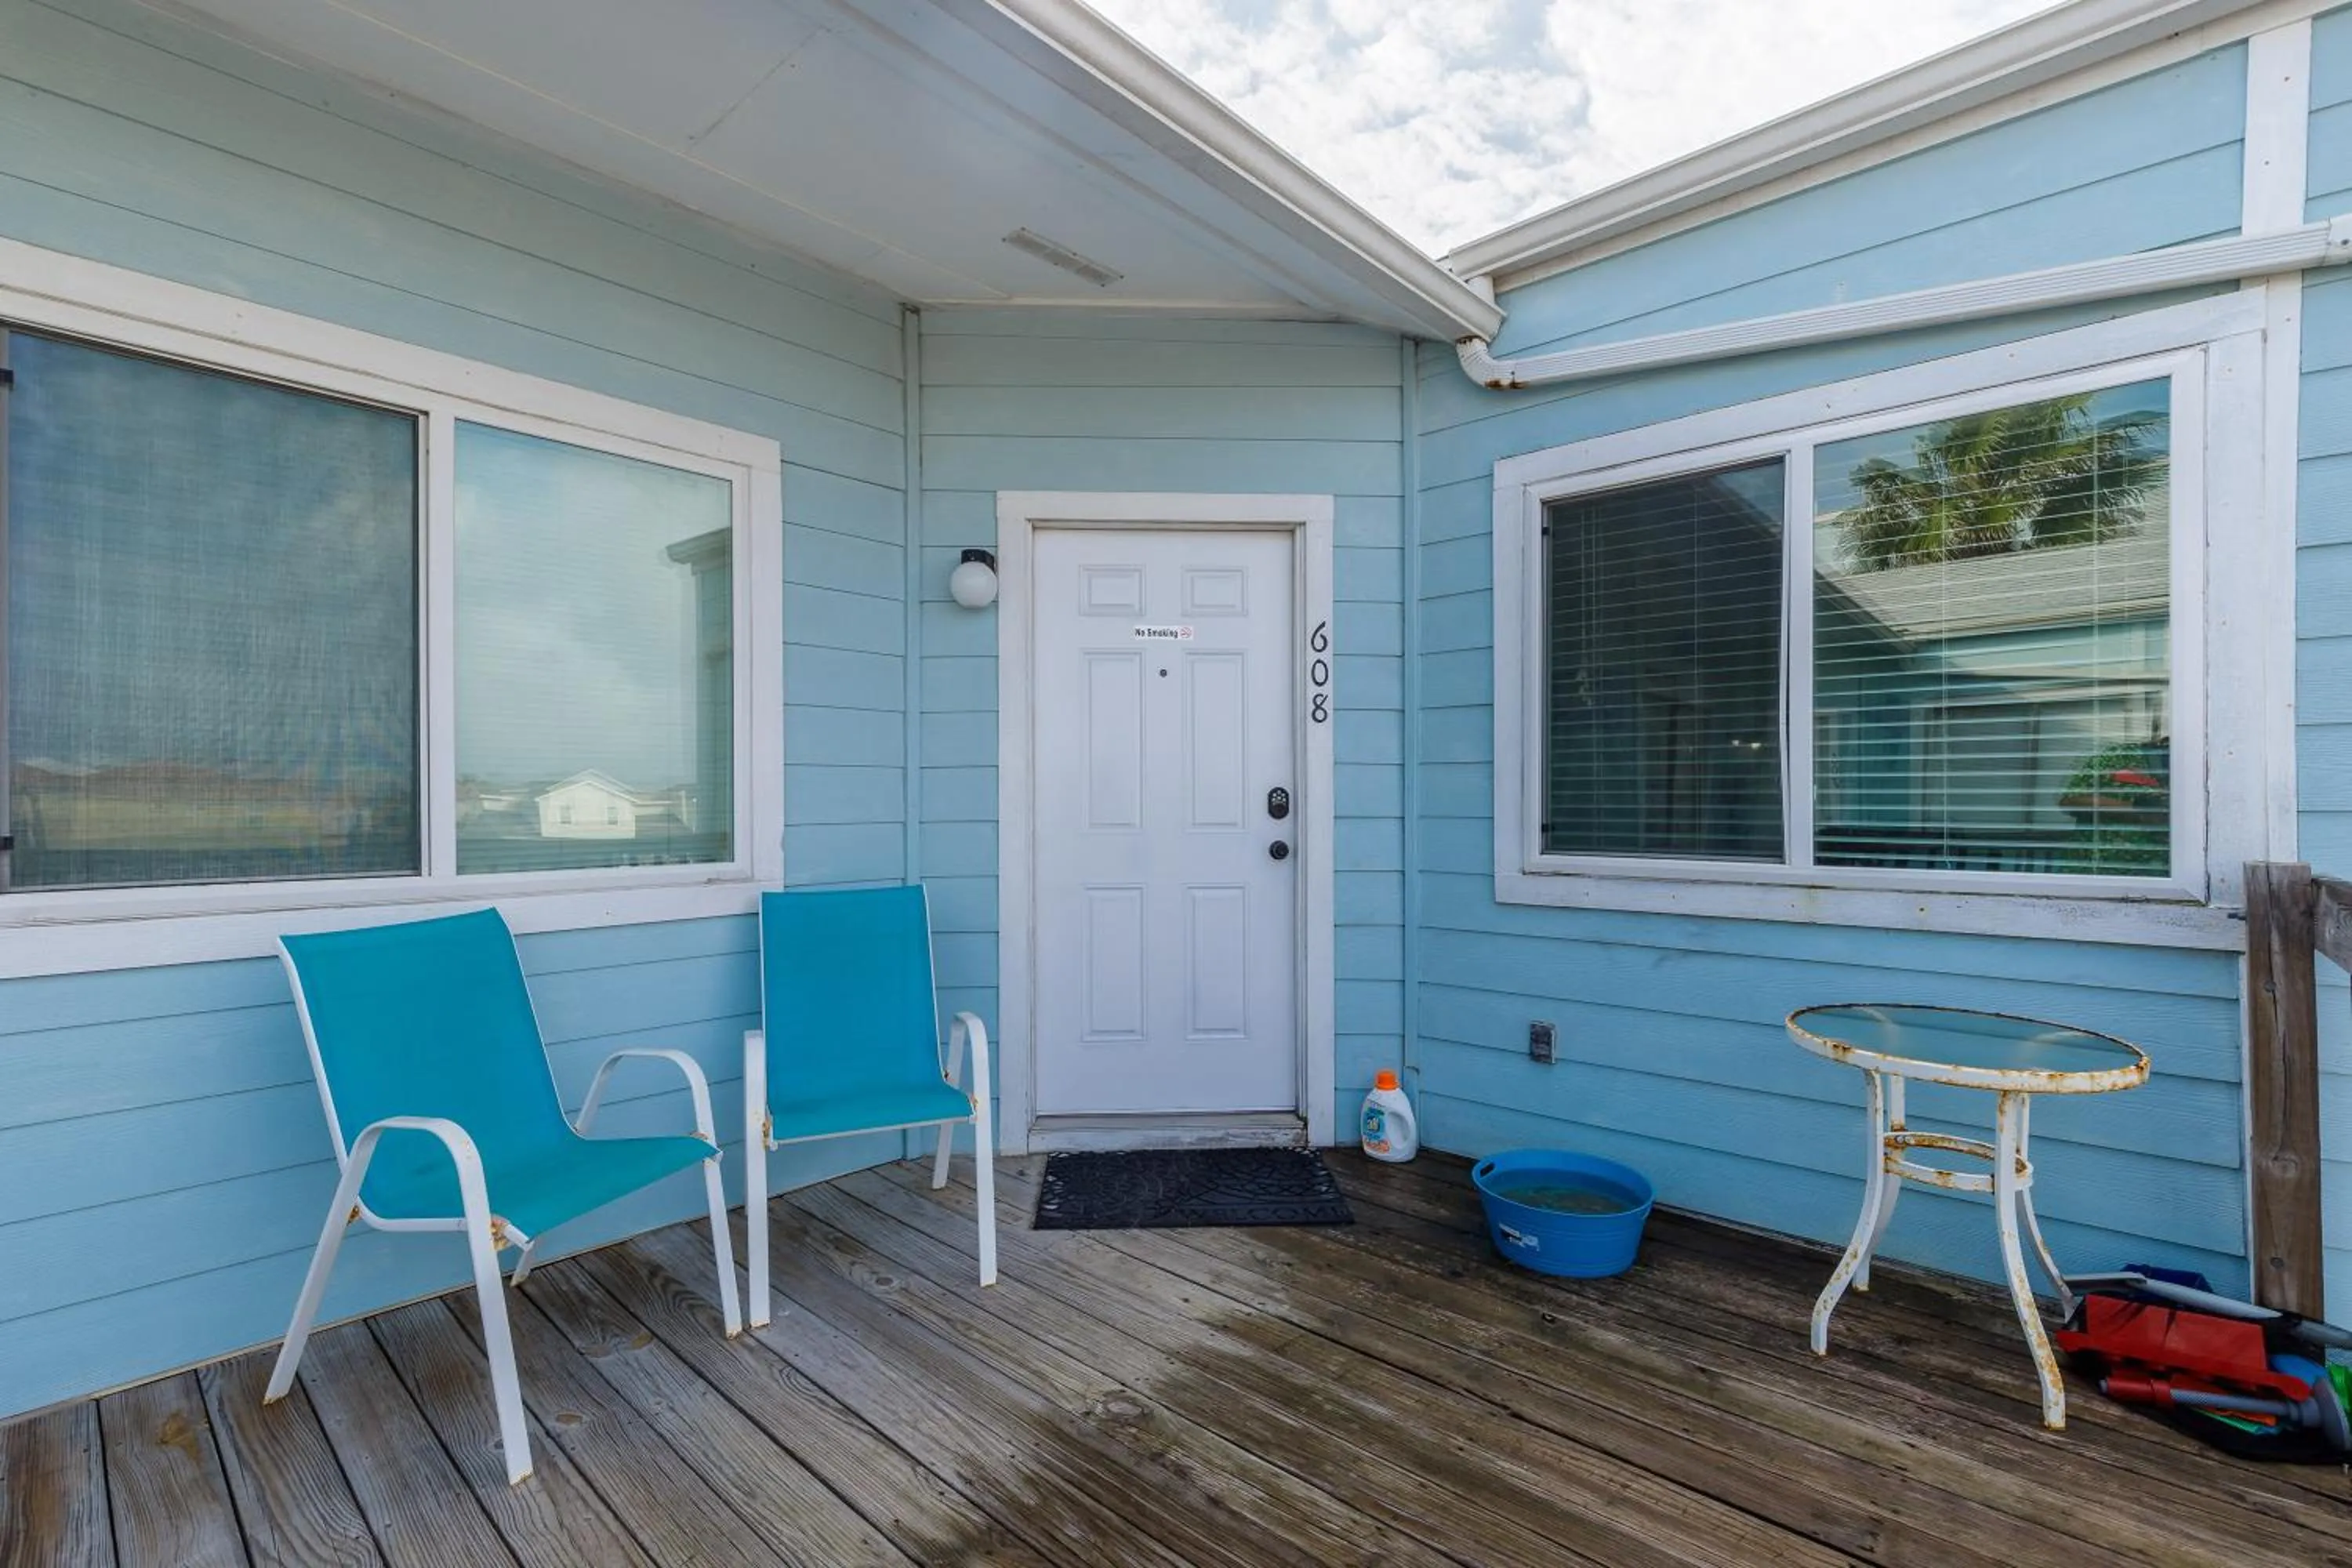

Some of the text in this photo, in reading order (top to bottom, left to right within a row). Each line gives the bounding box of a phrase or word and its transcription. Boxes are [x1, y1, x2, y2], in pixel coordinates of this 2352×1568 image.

[1134, 628, 1178, 639] No Smoking
[1311, 621, 1329, 723] 608
